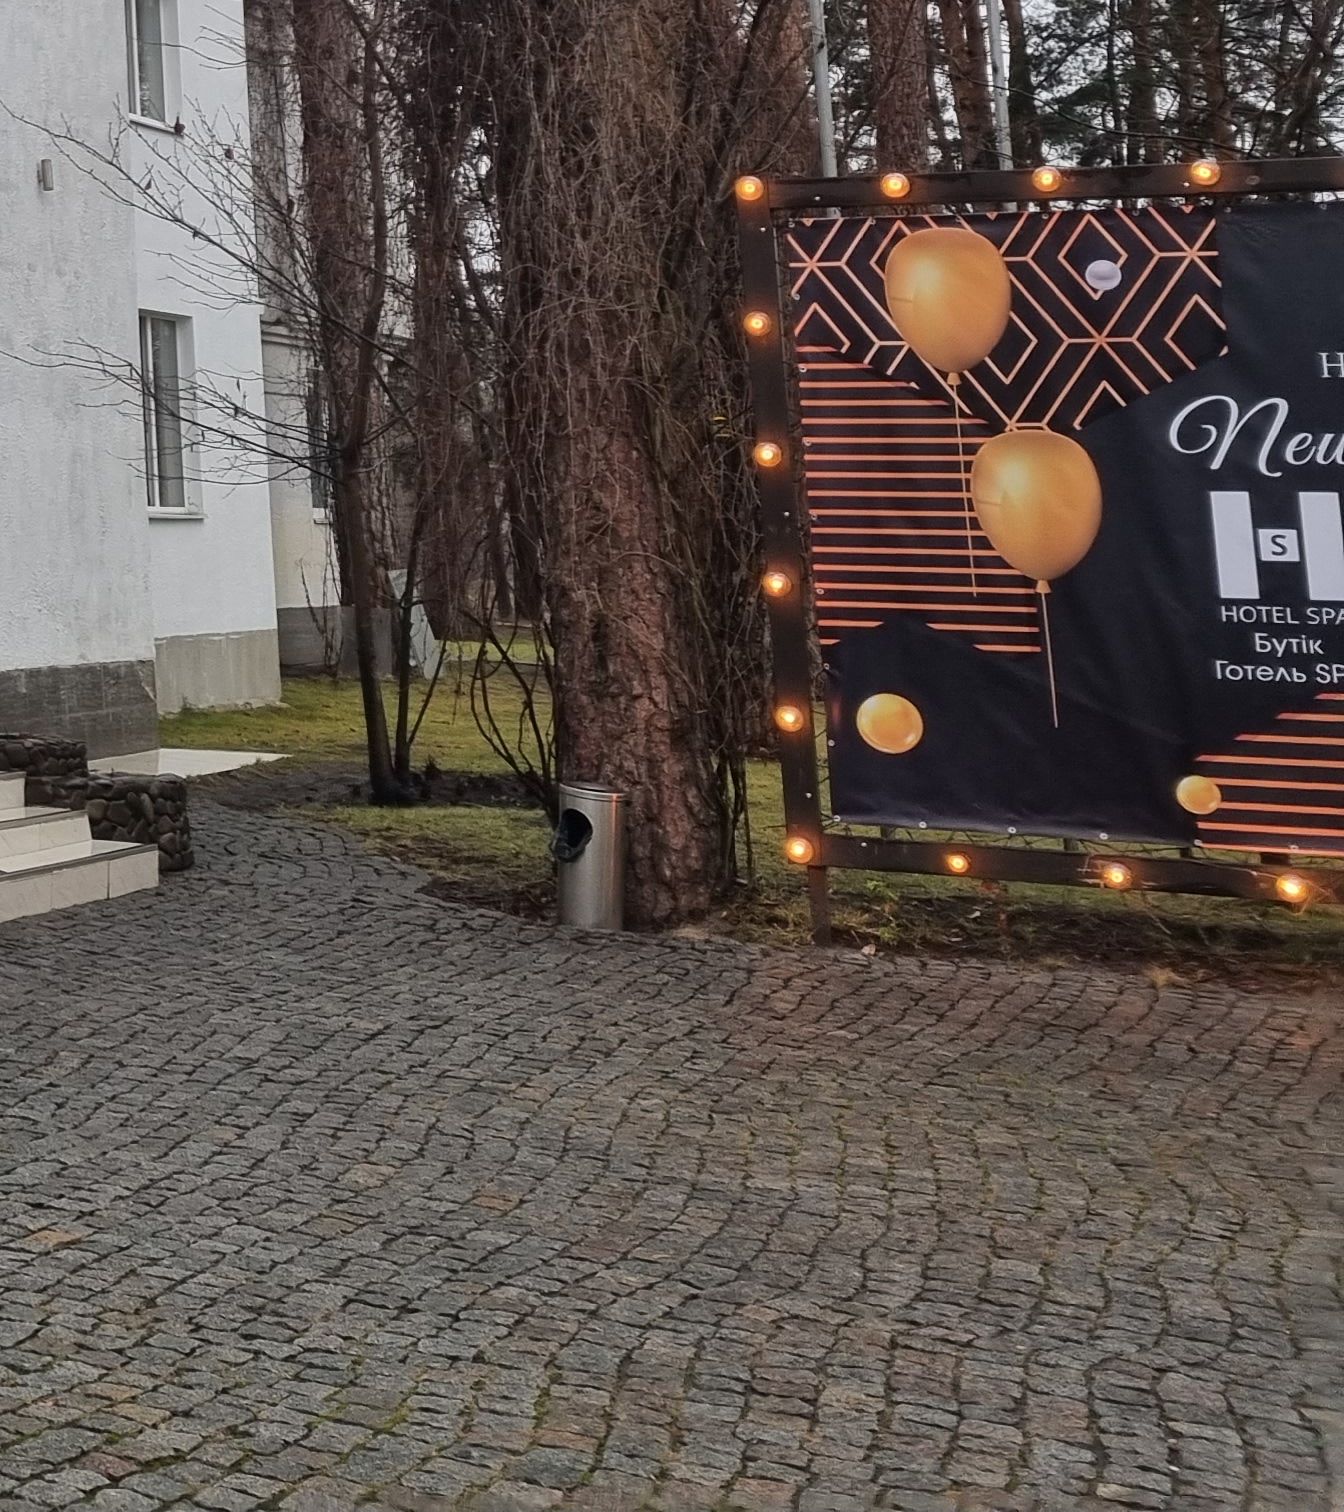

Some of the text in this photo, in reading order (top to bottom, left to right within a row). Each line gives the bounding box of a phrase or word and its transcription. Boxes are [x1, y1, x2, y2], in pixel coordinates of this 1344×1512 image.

[1221, 606, 1300, 624] HOTEL
[1255, 633, 1325, 658] Бутік
[1215, 660, 1307, 683] Готель
